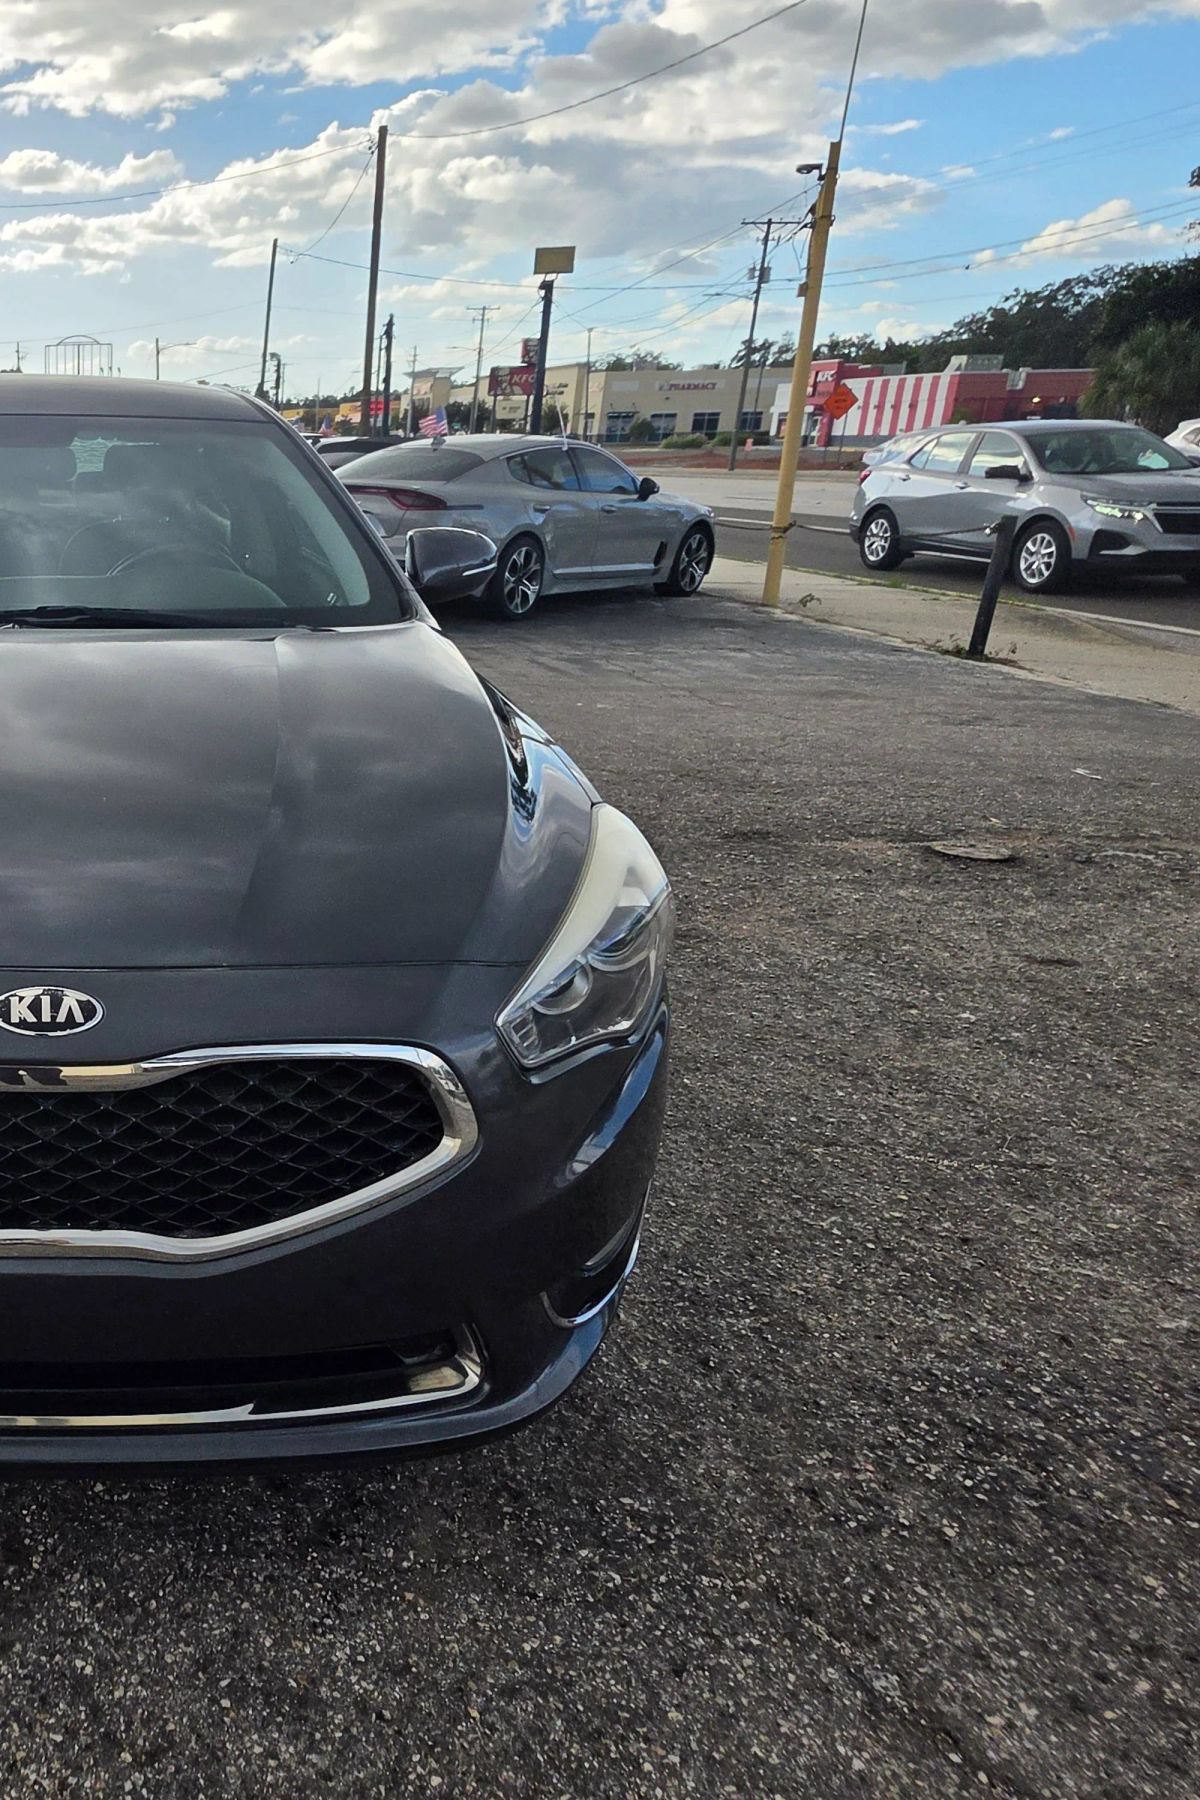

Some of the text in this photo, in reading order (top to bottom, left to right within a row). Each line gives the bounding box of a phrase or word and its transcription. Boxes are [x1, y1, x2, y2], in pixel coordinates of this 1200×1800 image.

[511, 374, 536, 384] KFC
[816, 370, 837, 382] KFC
[9, 995, 85, 1023] KIA
